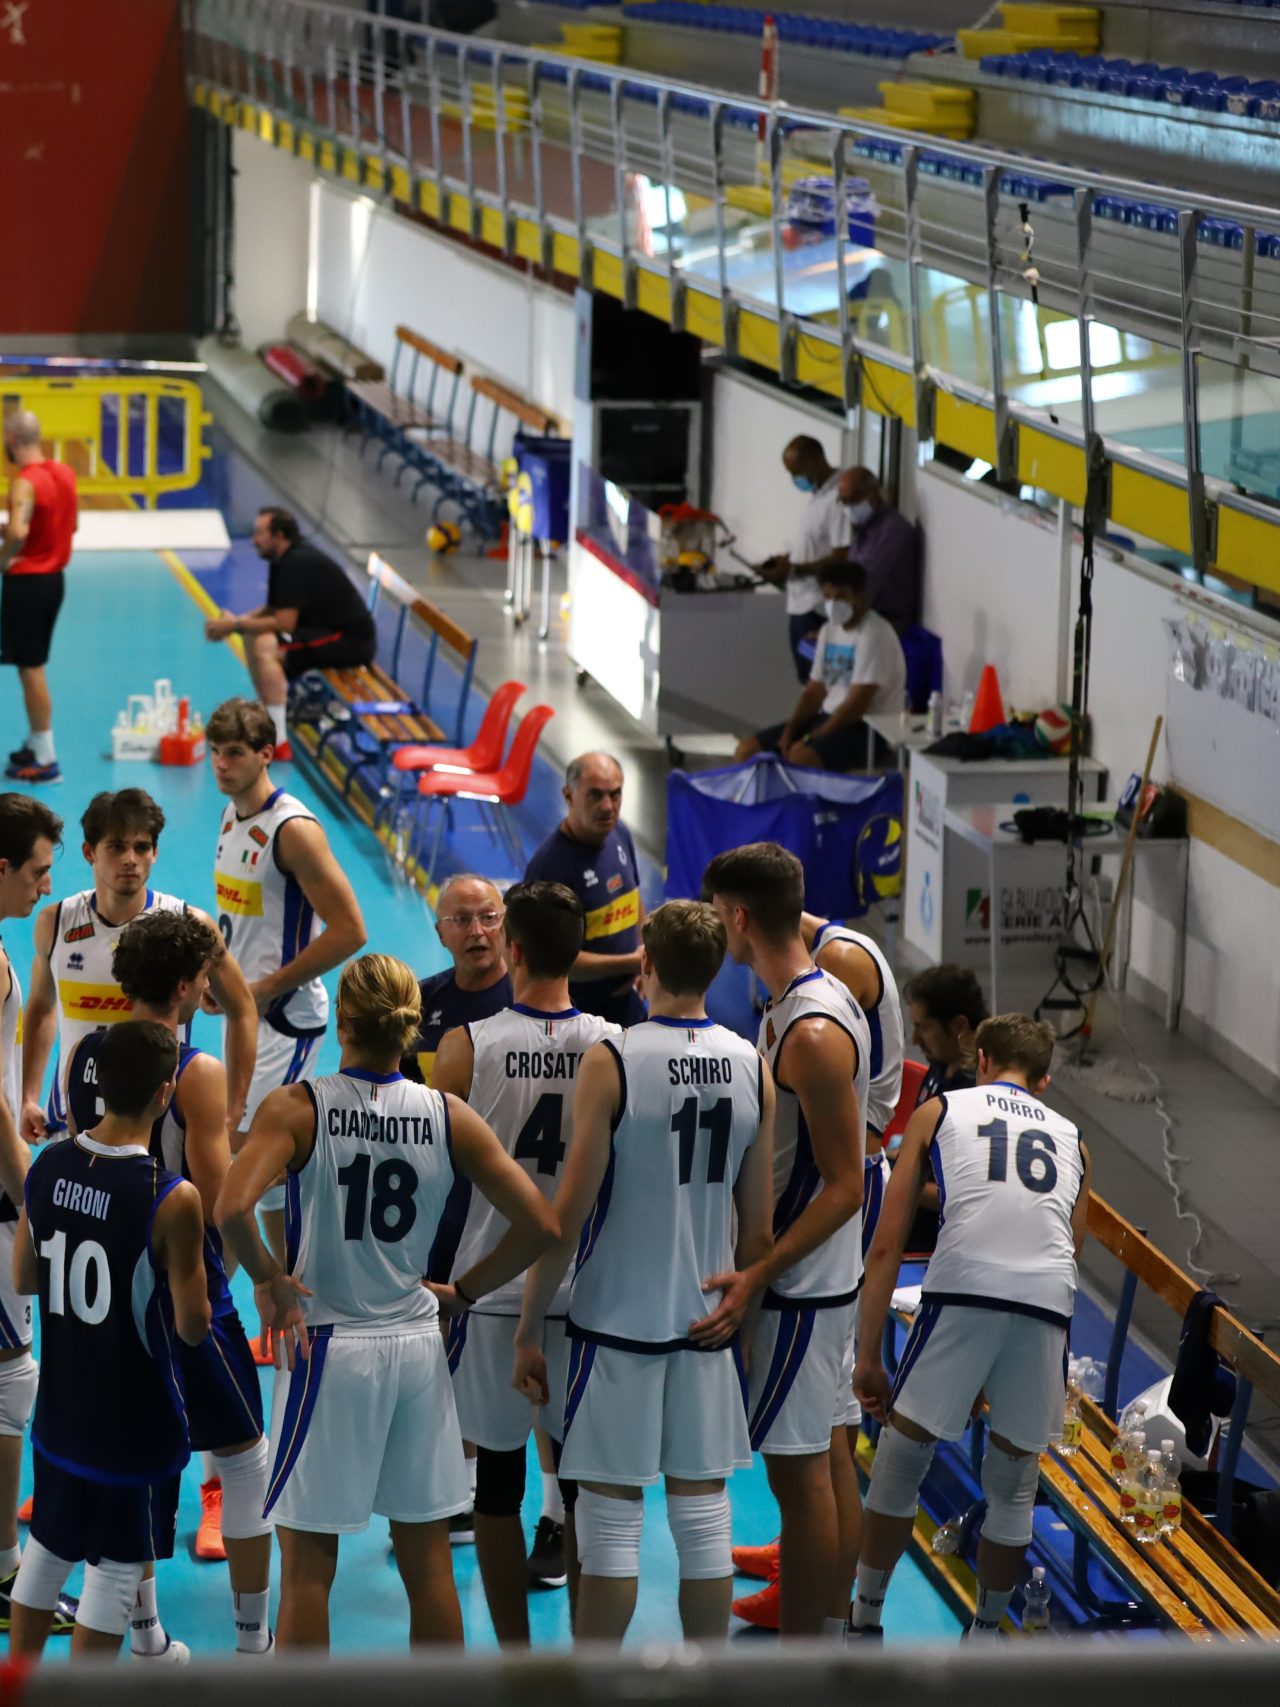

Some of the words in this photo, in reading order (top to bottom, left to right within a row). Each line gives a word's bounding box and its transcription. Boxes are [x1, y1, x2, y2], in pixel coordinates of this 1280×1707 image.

[603, 904, 634, 925] DHL
[668, 1057, 732, 1086] SCHIRO
[328, 1107, 433, 1146] CIANCIOTTA
[986, 1093, 1046, 1122] PORRO
[514, 1092, 566, 1177] 4
[671, 1096, 732, 1186] 11
[977, 1117, 1058, 1194] 16
[52, 1177, 111, 1221] GIRONI
[338, 1153, 418, 1243] 18
[40, 1229, 112, 1326] 10
[24, 1306, 32, 1325] 3
